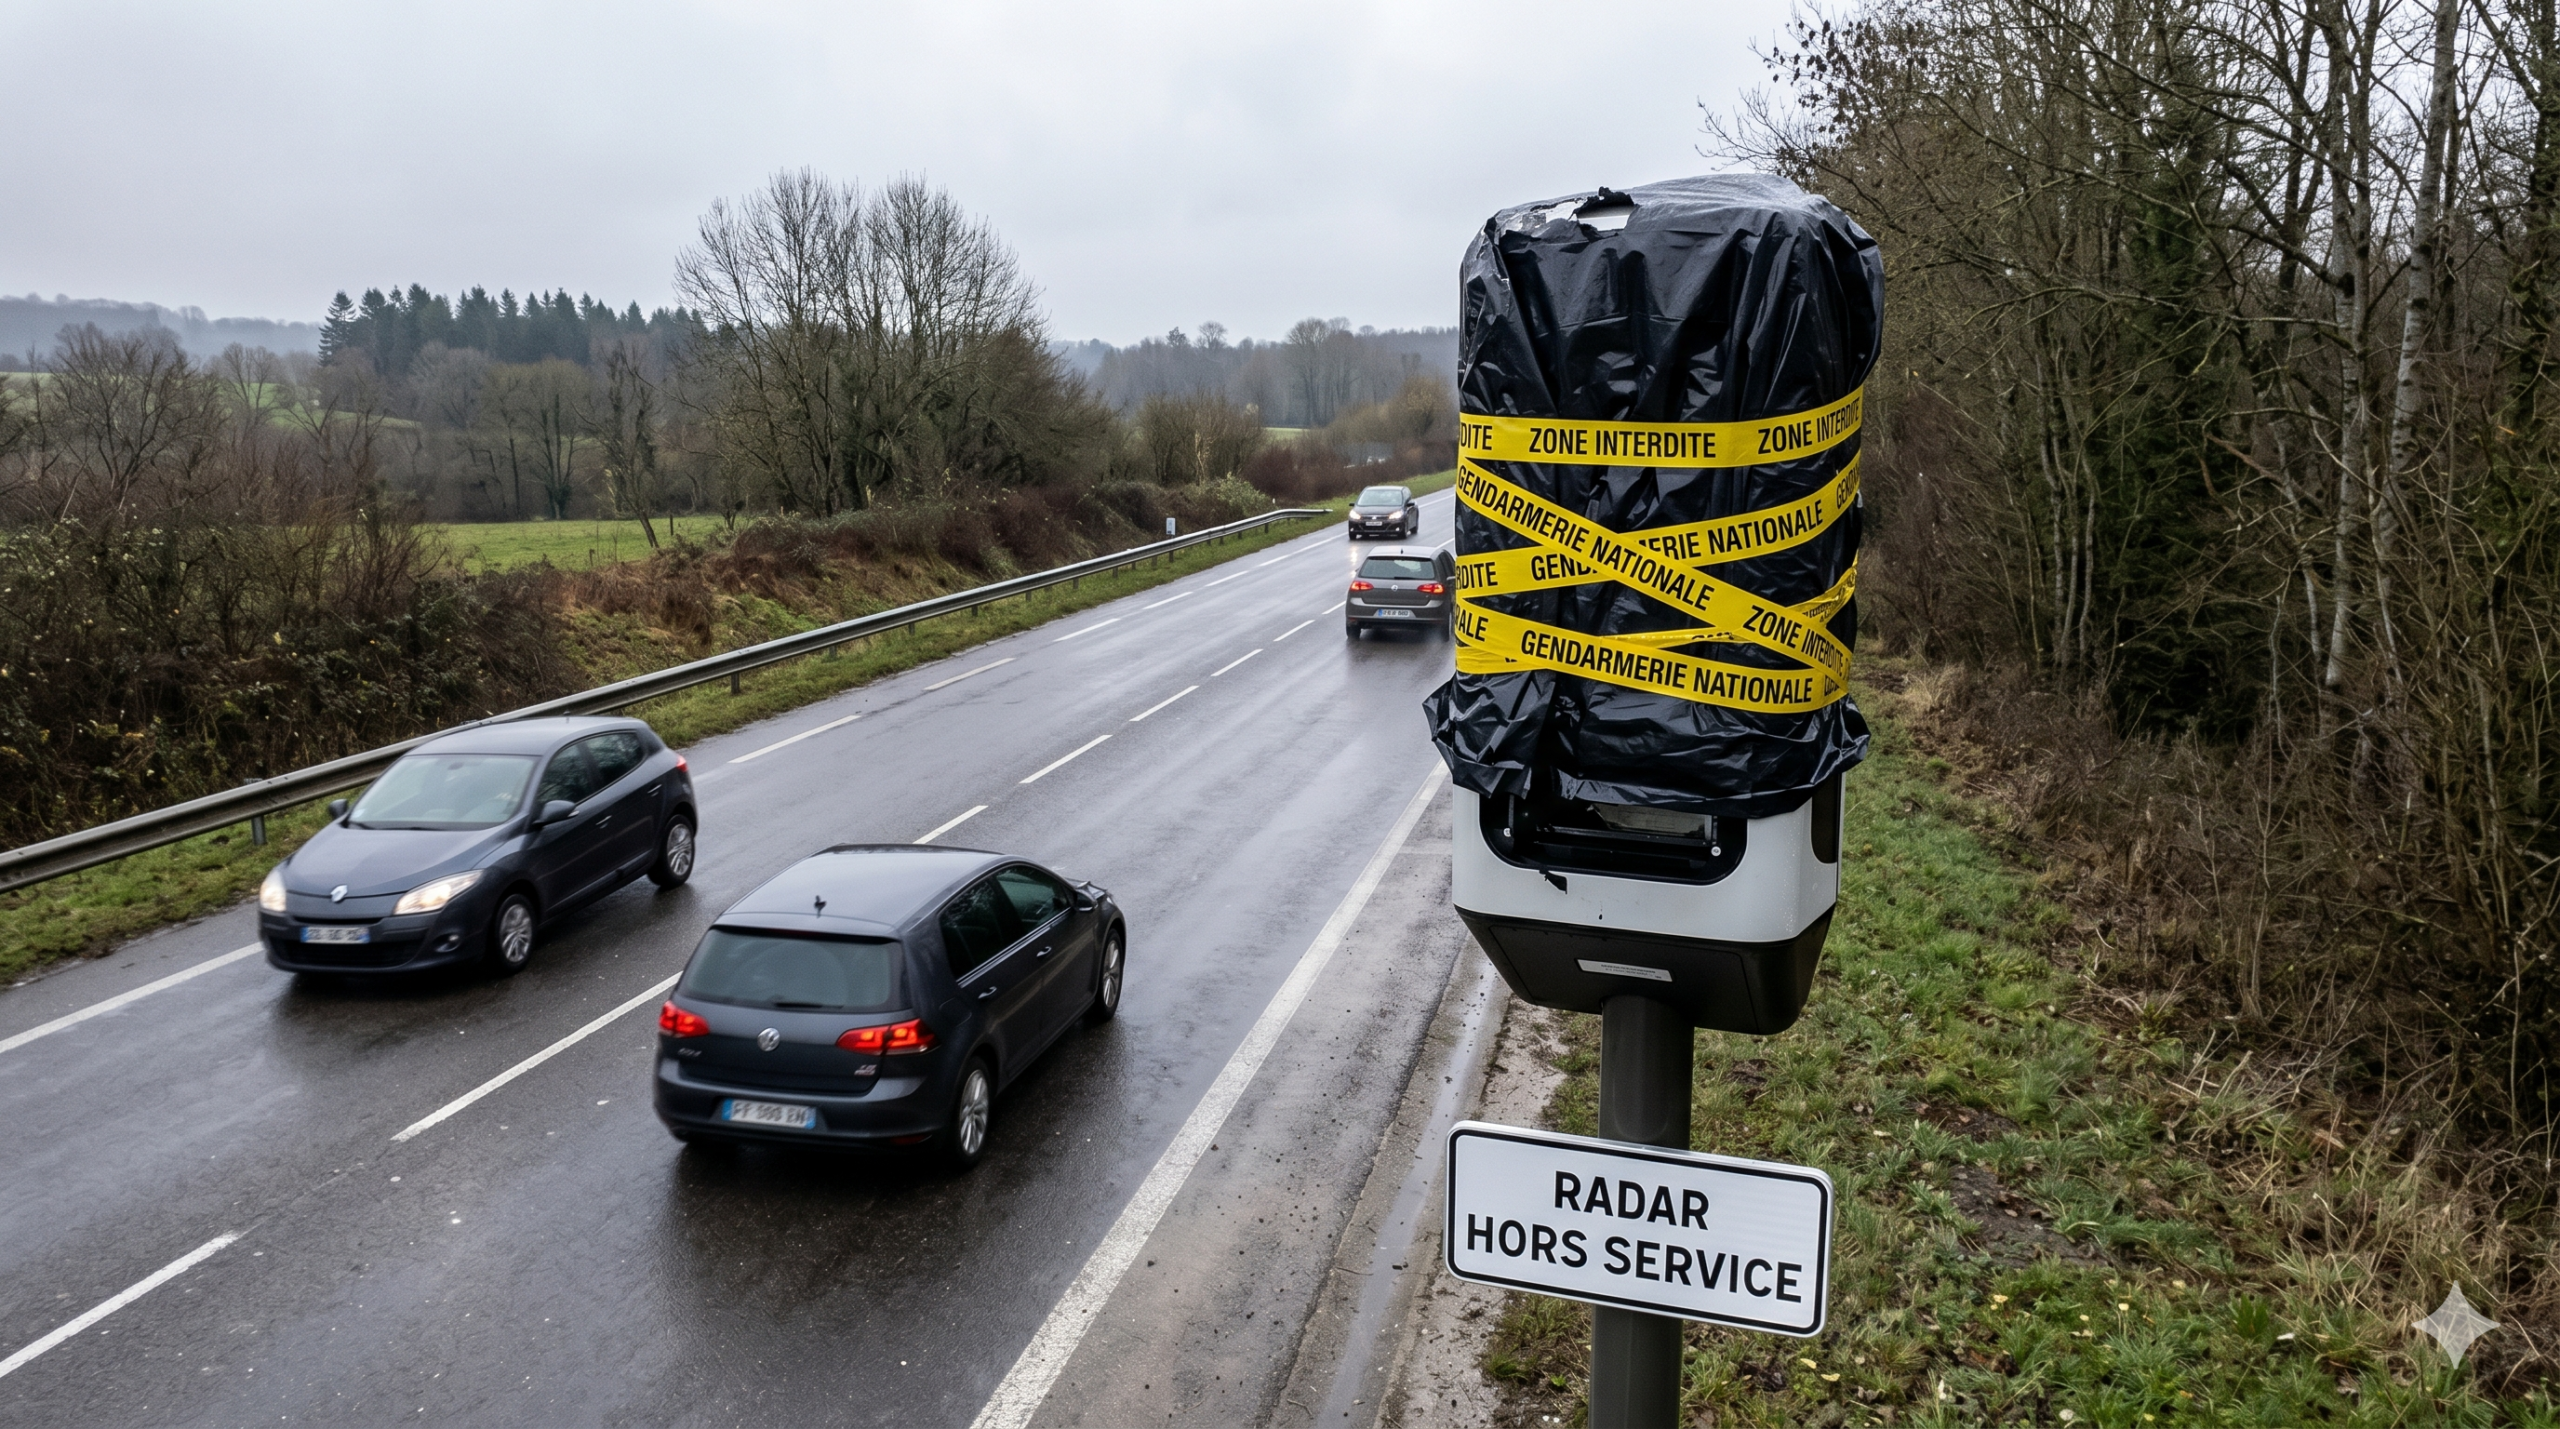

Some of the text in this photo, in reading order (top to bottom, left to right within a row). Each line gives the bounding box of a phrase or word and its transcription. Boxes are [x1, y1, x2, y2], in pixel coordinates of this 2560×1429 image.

[1529, 427, 1588, 455] ZONE
[1596, 429, 1716, 458] INTERDITE
[1758, 420, 1813, 454] ZONE
[1458, 464, 1590, 553] GENDARMERIE
[1591, 535, 1715, 612] NATIONALE
[1742, 604, 1803, 649] ZONE
[1708, 499, 1824, 555] NATIONALE
[1521, 629, 1687, 689] GENDARMERIE
[1693, 667, 1813, 705] NATIONALE
[1554, 1170, 1709, 1230] RADAR
[1467, 1213, 1802, 1303] HORS SERVICE
